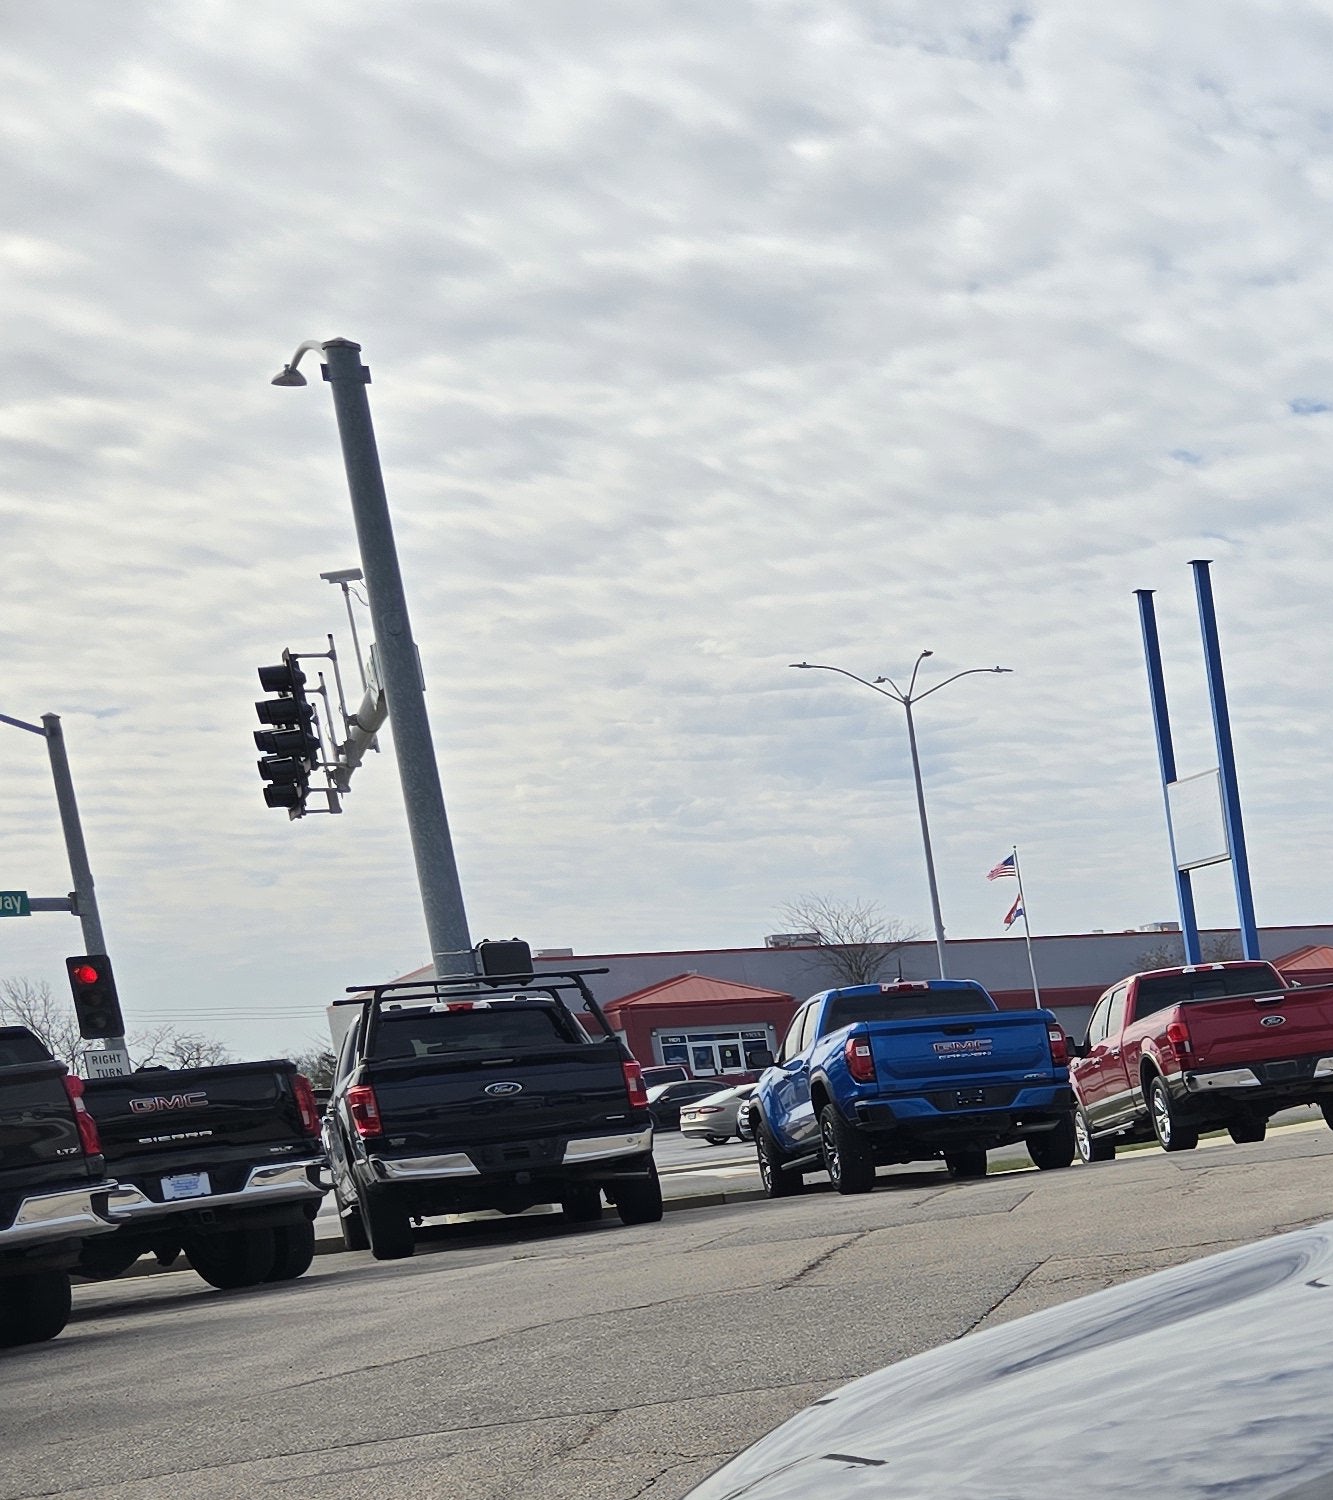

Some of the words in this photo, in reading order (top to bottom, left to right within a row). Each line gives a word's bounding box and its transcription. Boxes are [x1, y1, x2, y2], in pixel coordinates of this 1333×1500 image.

[932, 1039, 993, 1055] GMC
[91, 1054, 122, 1065] RIGHT
[96, 1068, 124, 1078] TURN
[129, 1092, 209, 1113] GMC
